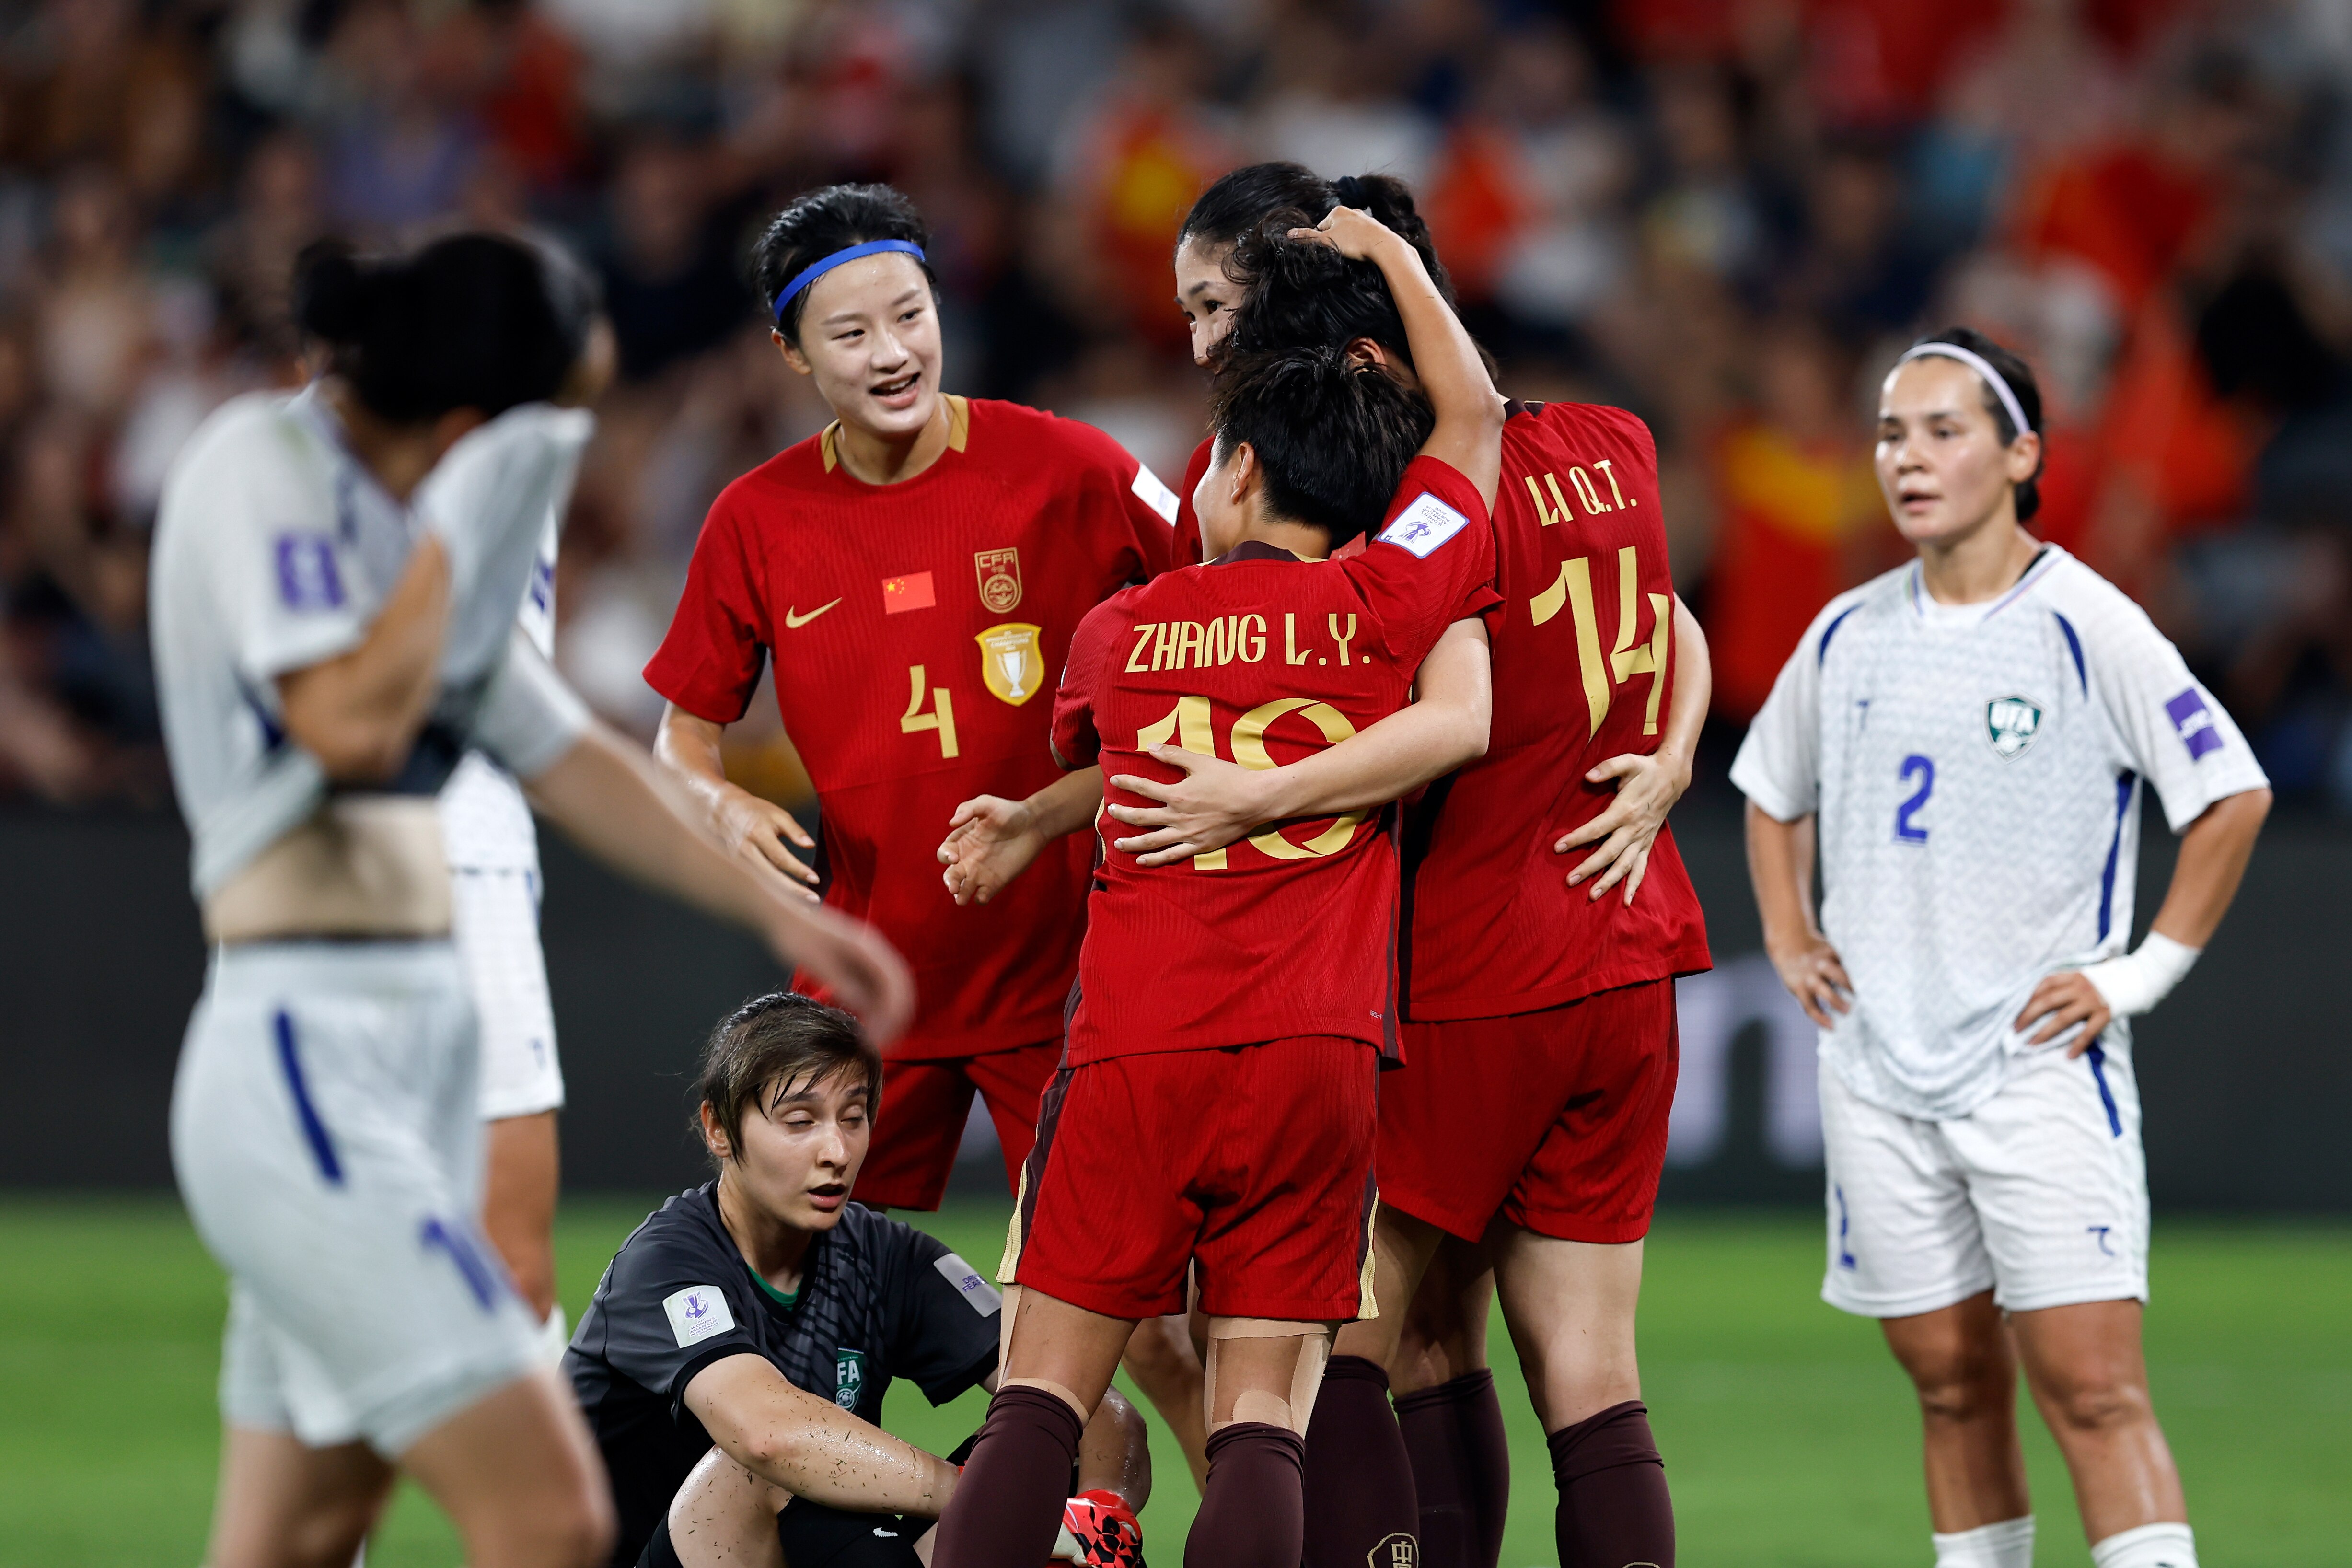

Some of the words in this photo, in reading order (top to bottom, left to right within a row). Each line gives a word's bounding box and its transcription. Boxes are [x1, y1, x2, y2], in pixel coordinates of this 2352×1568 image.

[1524, 472, 1574, 526] LI
[1569, 459, 1637, 515] Q.T.
[979, 551, 1014, 569] CFA
[1124, 614, 1267, 673] ZHANG
[1285, 613, 1371, 666] L.Y.
[1529, 546, 1669, 744] 14
[900, 664, 959, 759] 4
[1896, 754, 1935, 844] 2
[836, 1359, 861, 1386] FA
